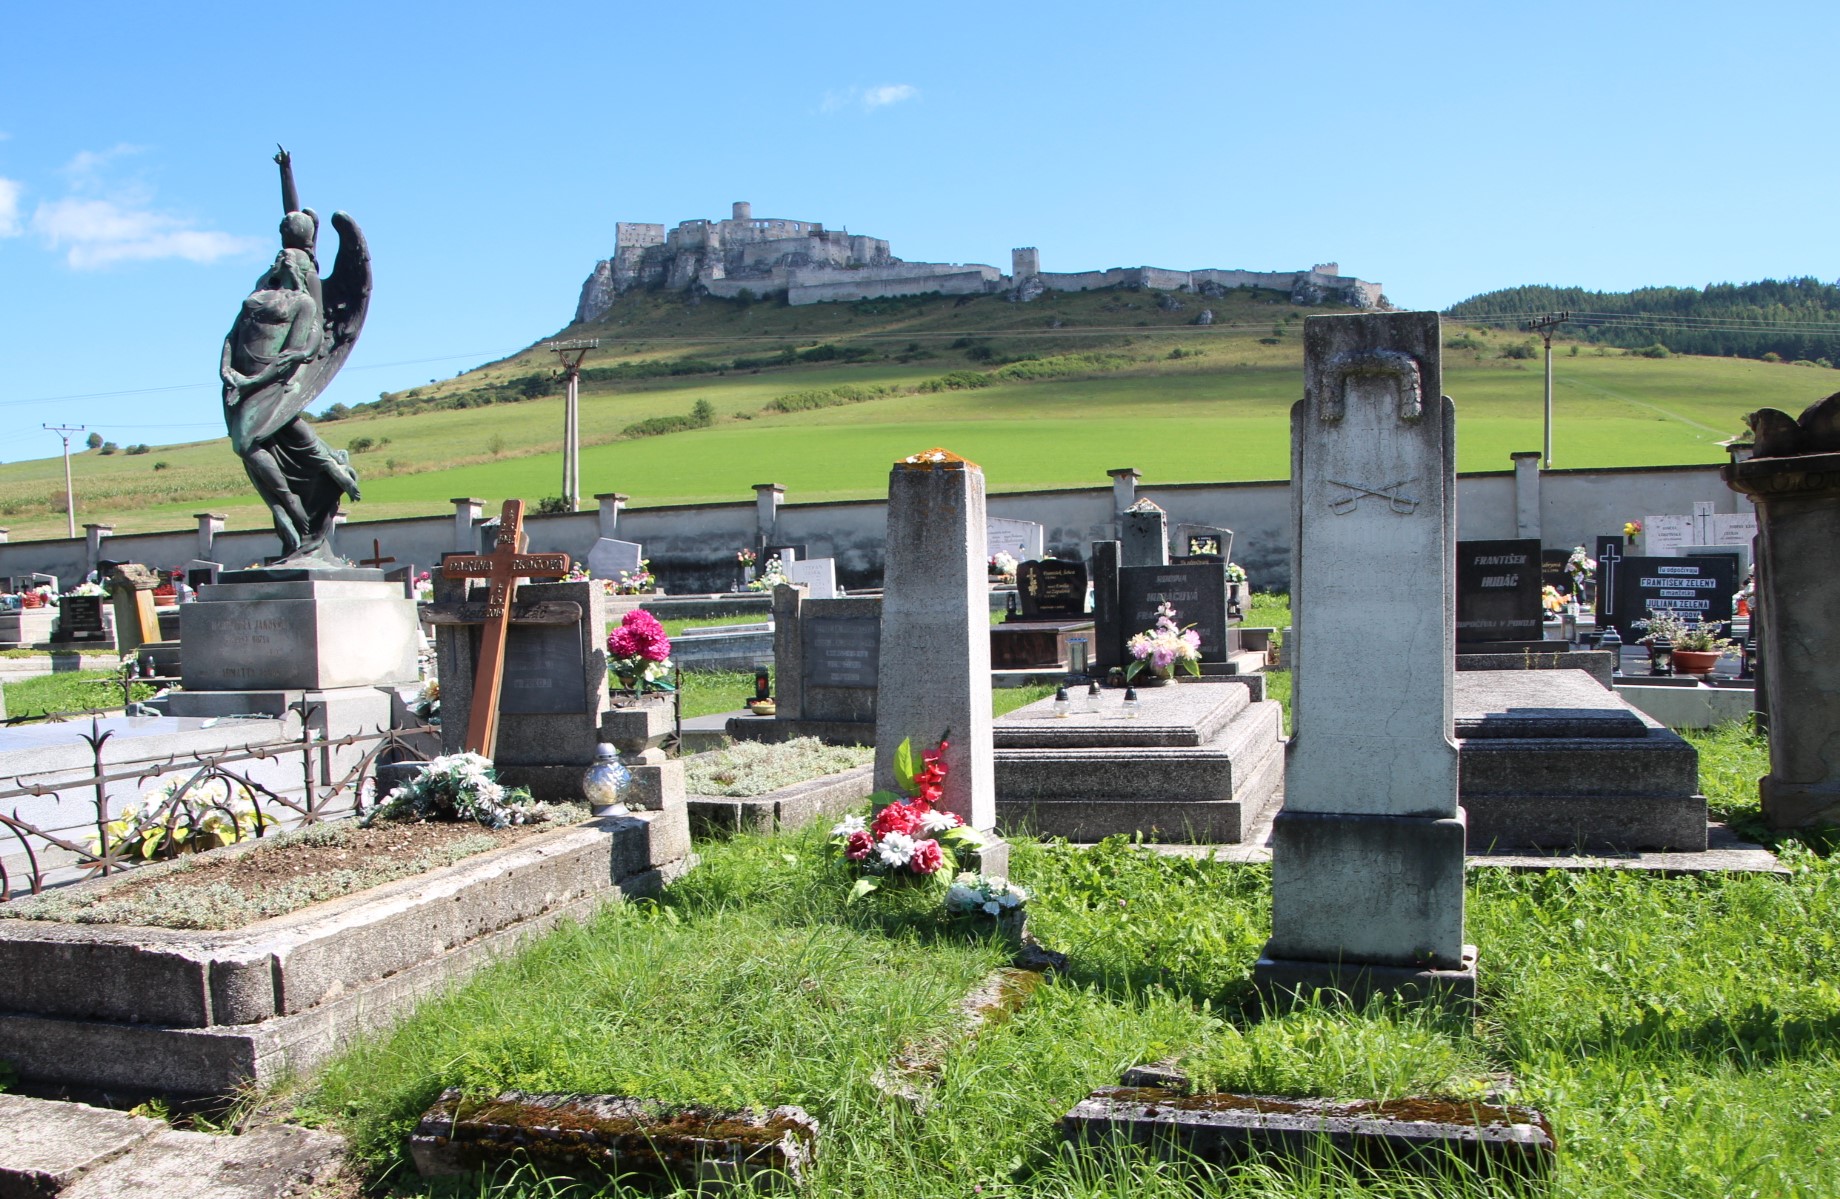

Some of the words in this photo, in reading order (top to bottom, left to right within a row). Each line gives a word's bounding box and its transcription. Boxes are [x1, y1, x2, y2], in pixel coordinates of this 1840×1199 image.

[449, 561, 493, 573] DARINA
[512, 556, 565, 571] TKÁČOVÁ
[1474, 553, 1527, 565] FRANTIŠEK
[1481, 573, 1519, 587] HUDÁČ
[1641, 577, 1683, 587] FRANTIŠEK
[1685, 577, 1715, 588] ZELENÝ
[1646, 599, 1677, 608] JULIANA
[1679, 598, 1709, 609] ZELENÁ
